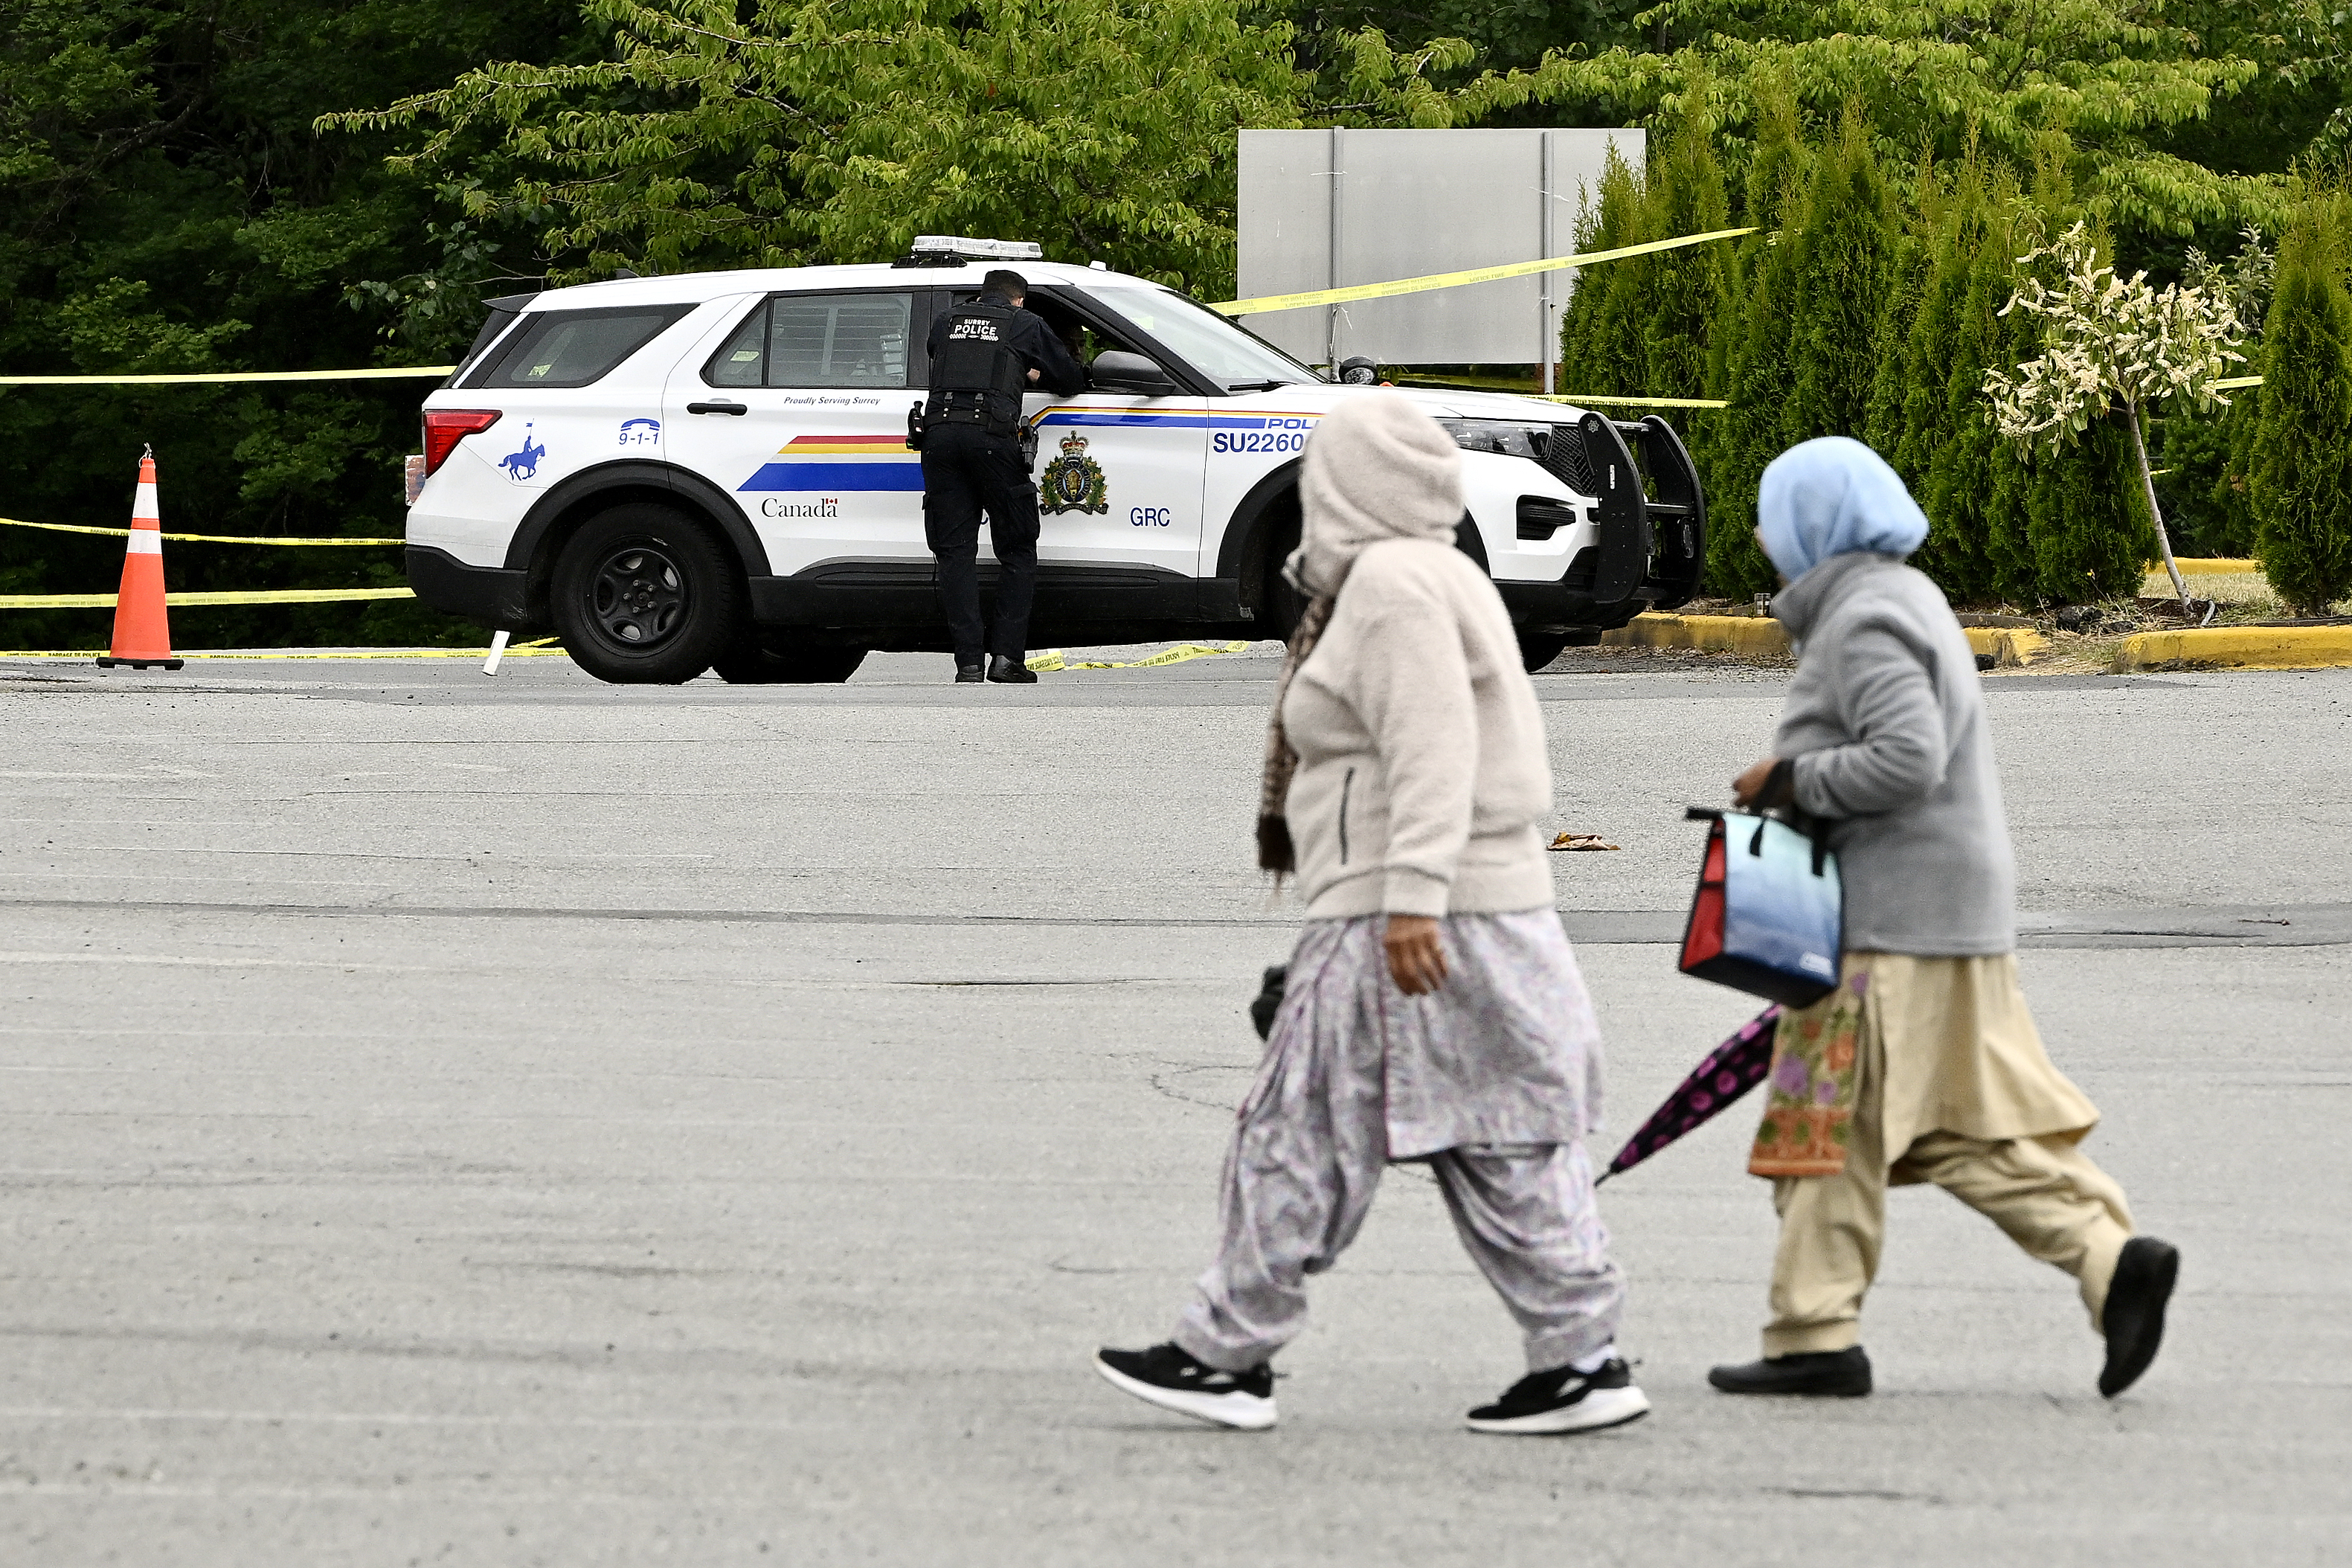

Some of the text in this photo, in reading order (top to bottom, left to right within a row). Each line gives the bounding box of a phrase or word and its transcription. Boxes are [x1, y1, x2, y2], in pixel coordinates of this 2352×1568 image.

[954, 324, 997, 335] POLICE
[784, 396, 881, 405] Proudly Serving Surrey
[1267, 419, 1320, 429] POLI
[619, 432, 659, 445] 9-1-1
[1213, 433, 1304, 452] SU2260
[762, 498, 838, 518] Canada
[1130, 507, 1171, 527] GRC
